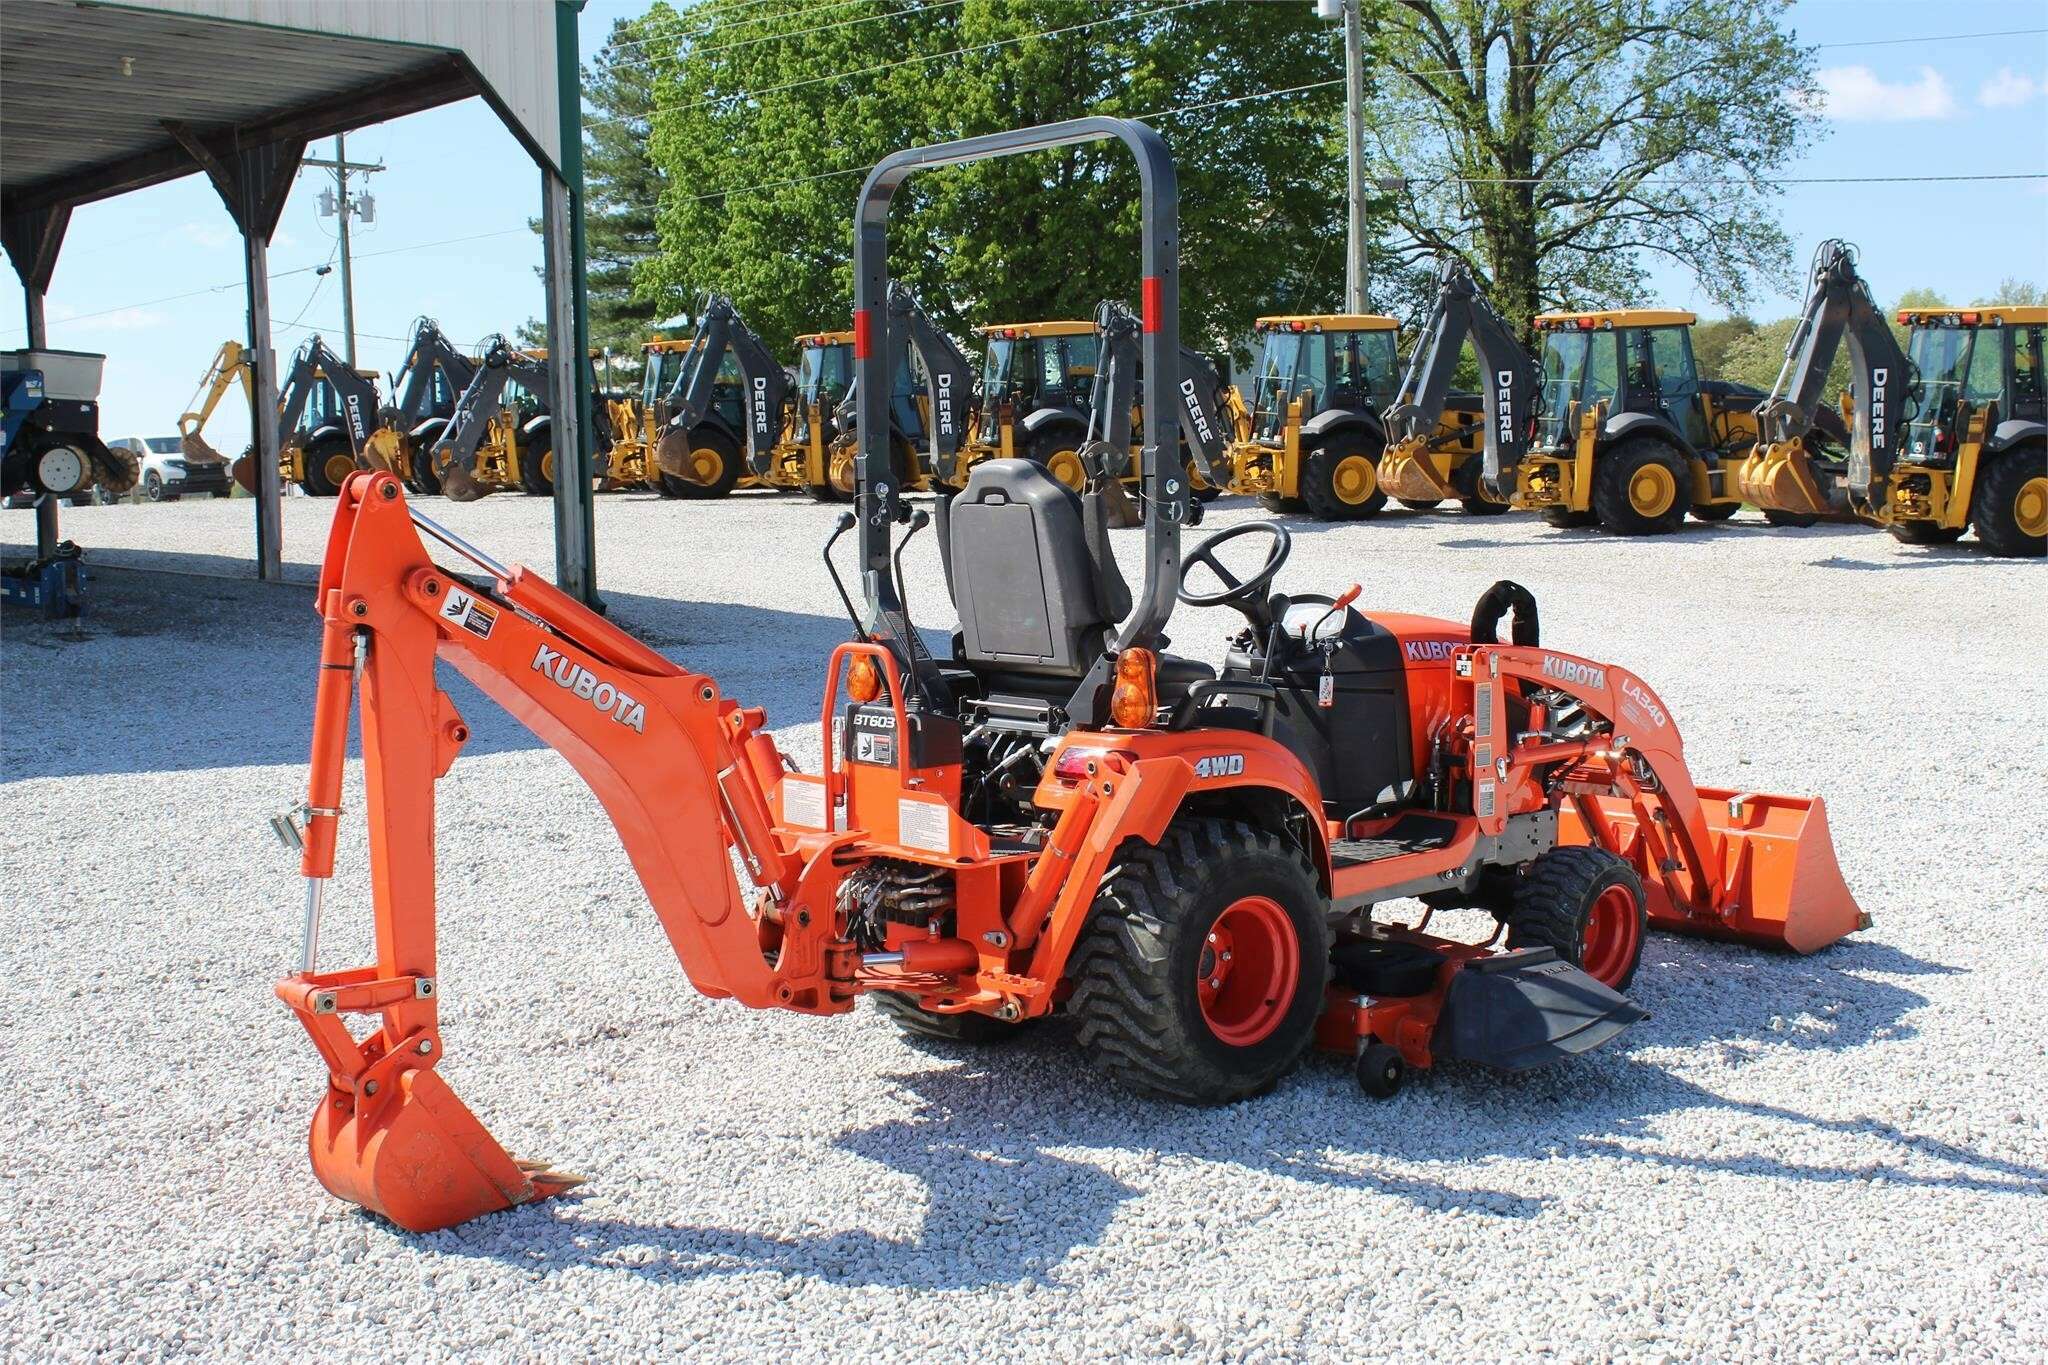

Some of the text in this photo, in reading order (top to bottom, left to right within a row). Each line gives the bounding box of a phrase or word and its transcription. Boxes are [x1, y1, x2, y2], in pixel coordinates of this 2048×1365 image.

[347, 394, 365, 440] DEERE
[753, 377, 768, 434] DEERE
[937, 373, 952, 435] DEERE
[1180, 378, 1213, 444] DEERE
[1498, 370, 1513, 444] DEERE
[1872, 368, 1888, 449] DEERE
[530, 642, 646, 735] KUBOTA
[1542, 654, 1606, 690] KUBOTA
[853, 714, 896, 729] BT603
[1195, 754, 1245, 779] 4WD
